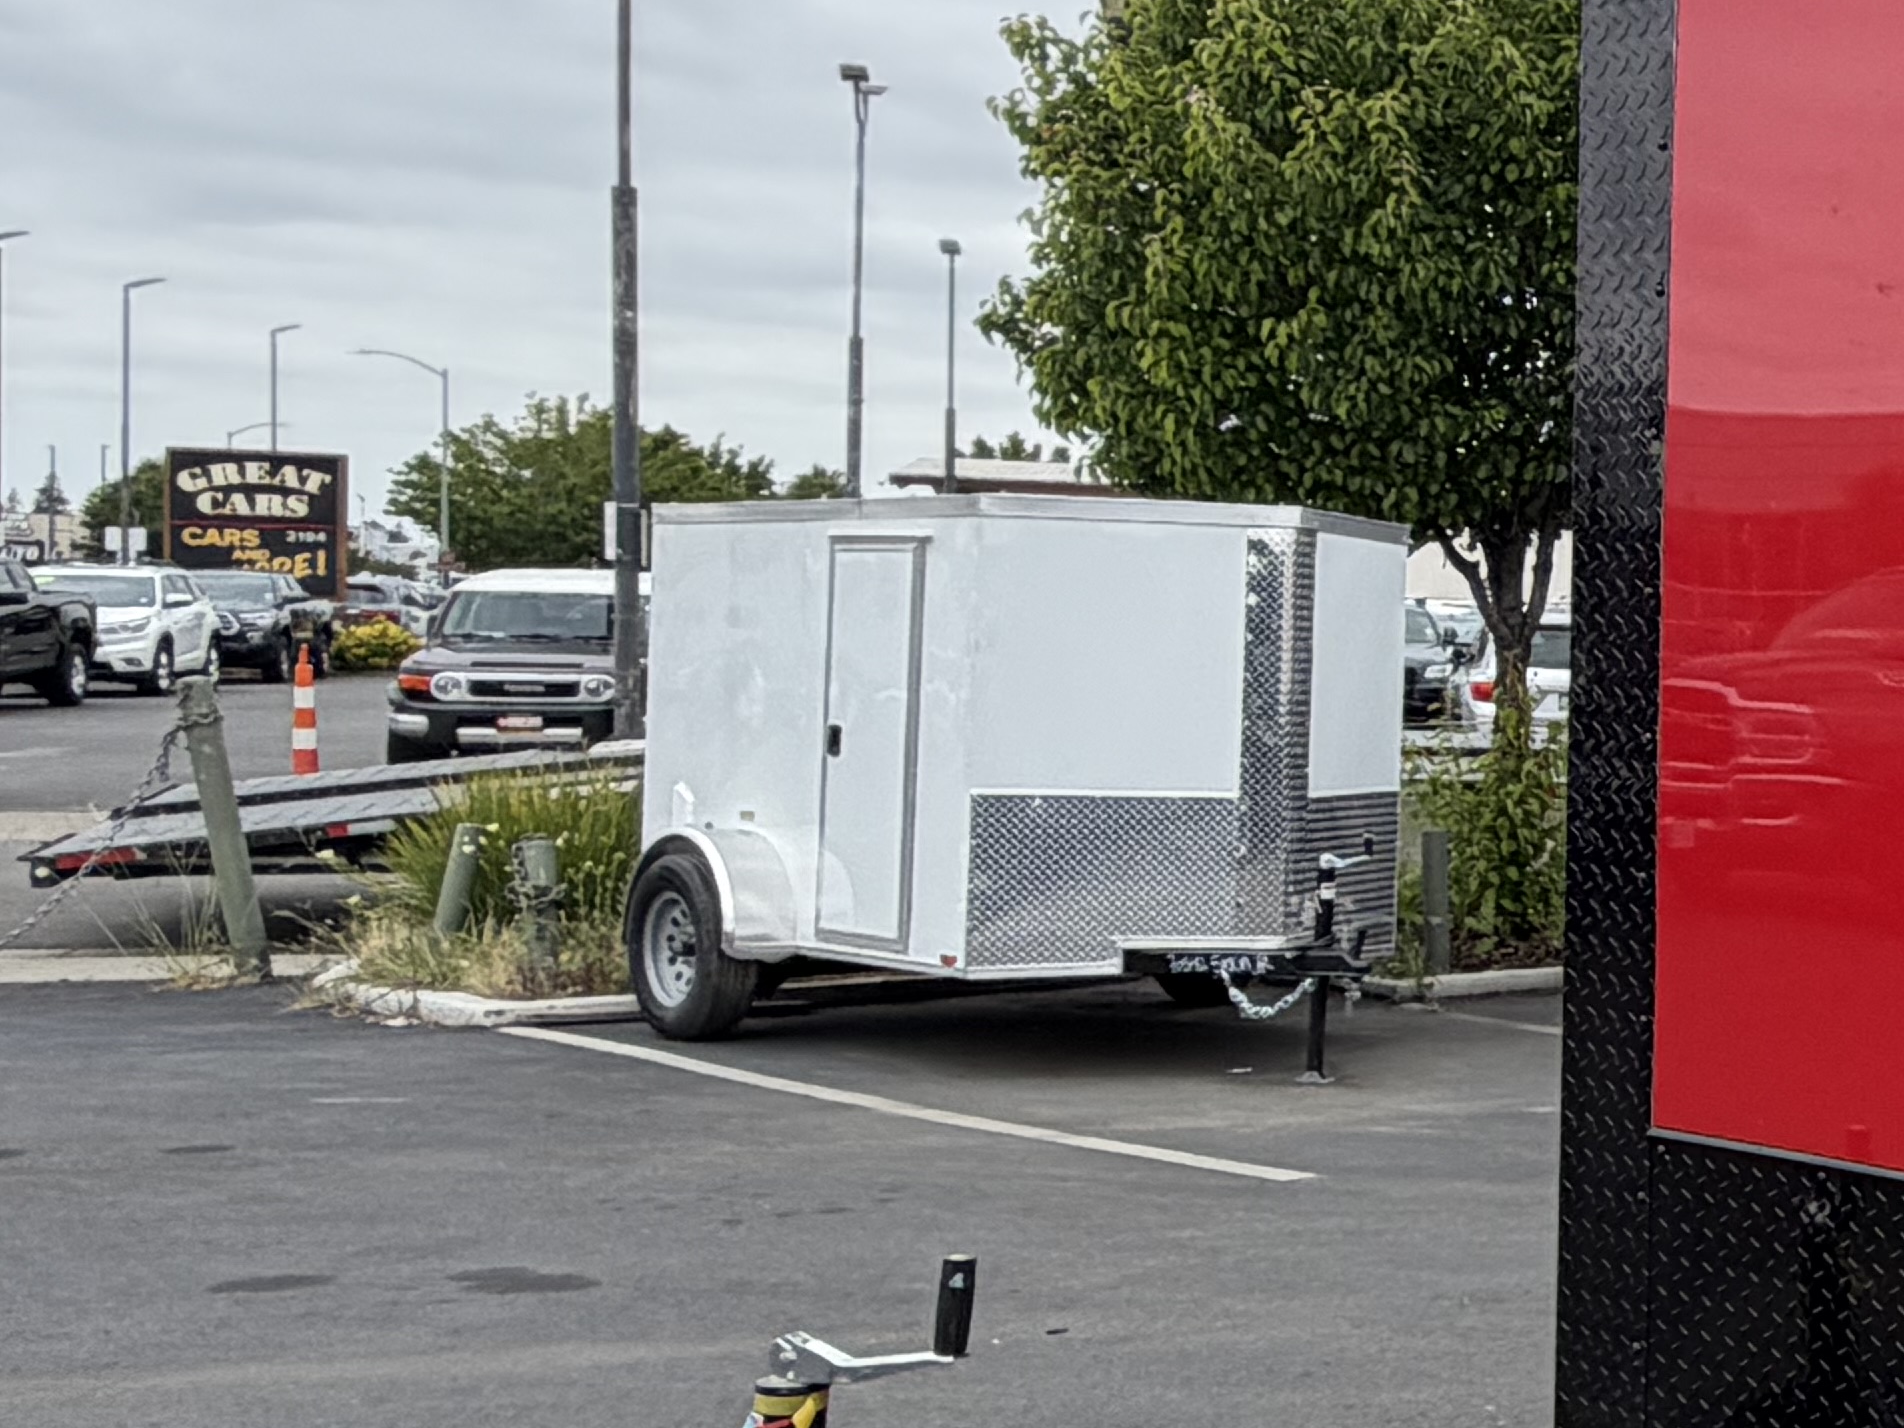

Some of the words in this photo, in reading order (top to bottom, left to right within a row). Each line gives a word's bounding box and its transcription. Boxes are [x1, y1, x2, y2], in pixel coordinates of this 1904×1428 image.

[176, 461, 332, 495] GREAT
[196, 491, 309, 518] CARS
[181, 527, 261, 548] CARS
[231, 549, 271, 561] AND
